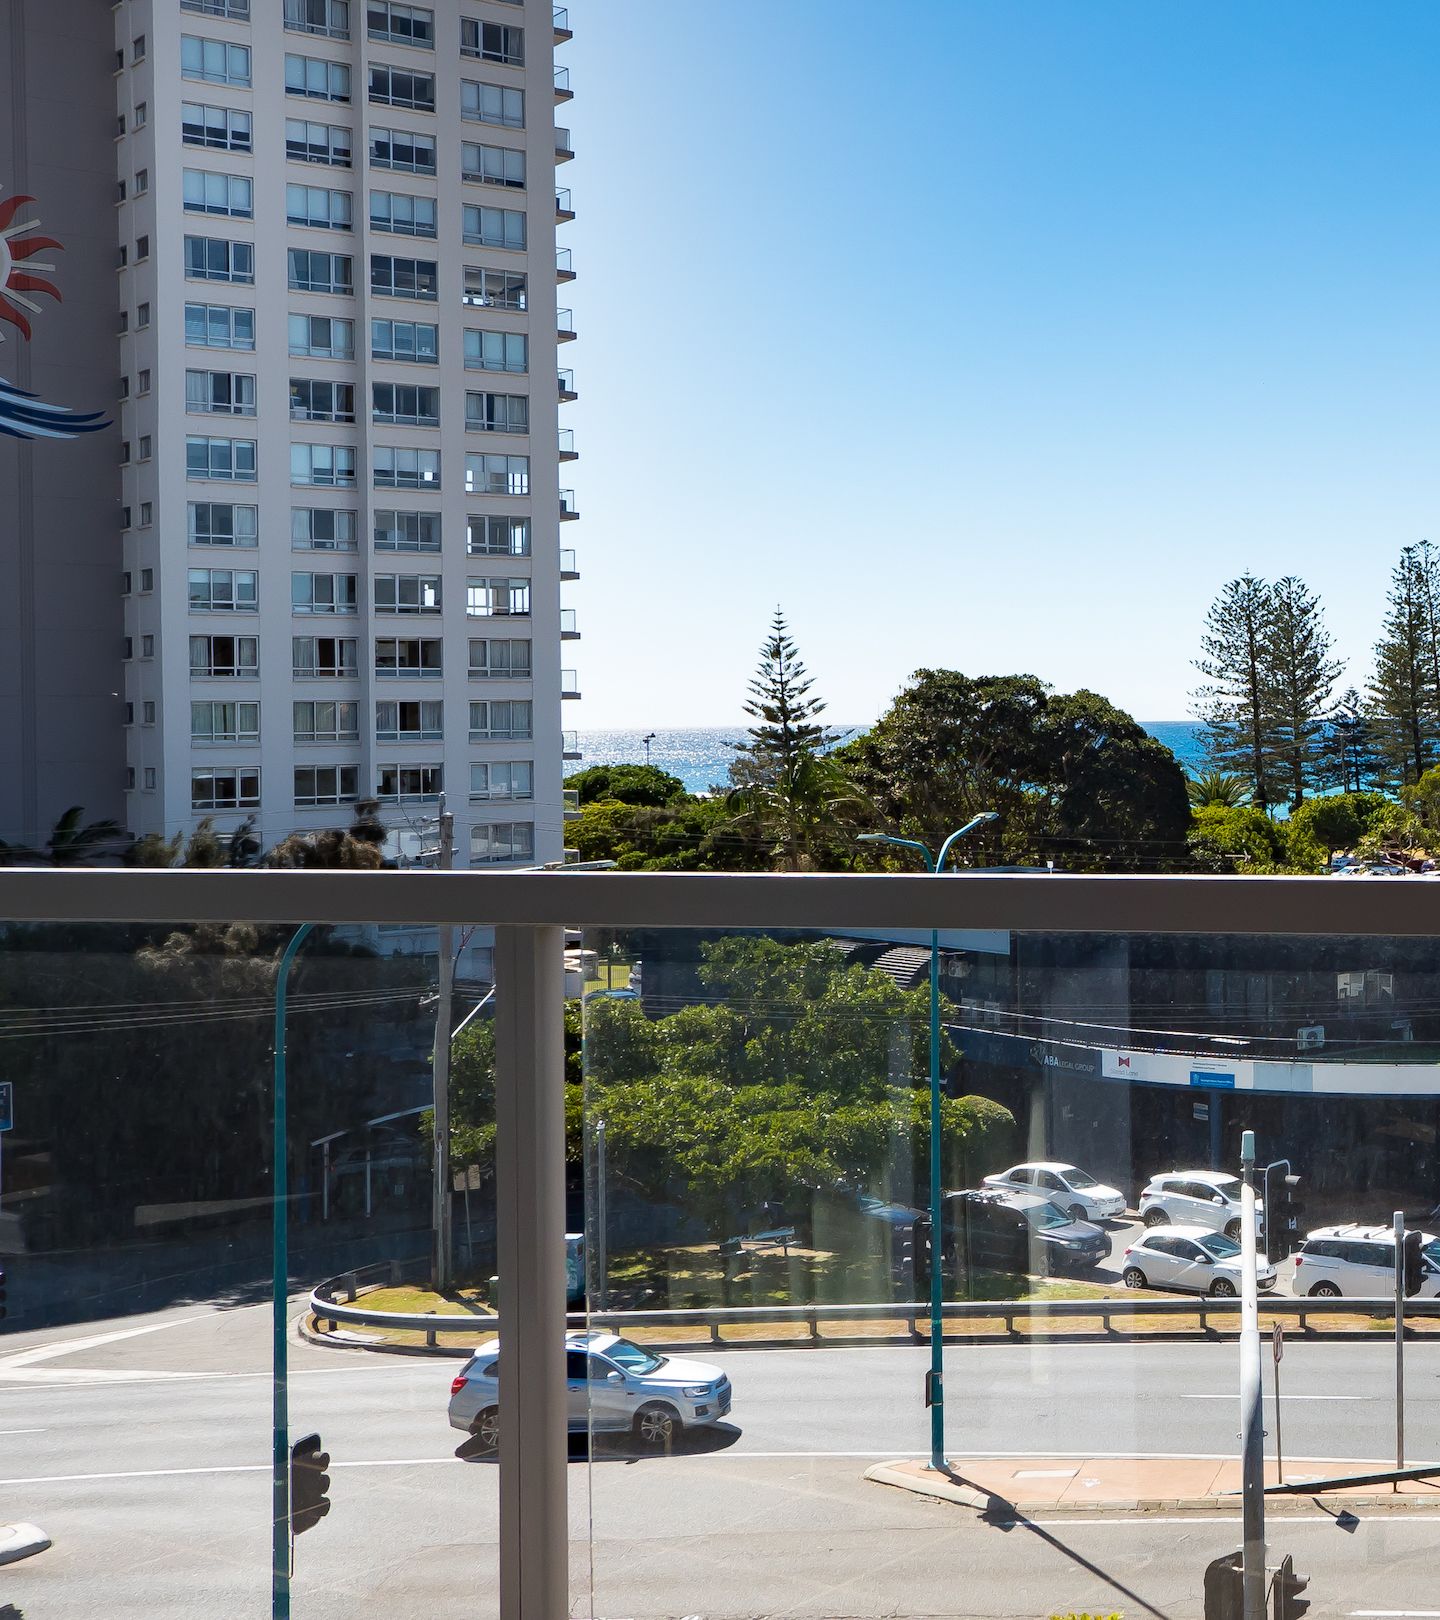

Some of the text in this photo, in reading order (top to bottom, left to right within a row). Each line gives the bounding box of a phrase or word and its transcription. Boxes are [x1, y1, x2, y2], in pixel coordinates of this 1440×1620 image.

[1044, 1055, 1095, 1072] ABA LEGAL GROUP
